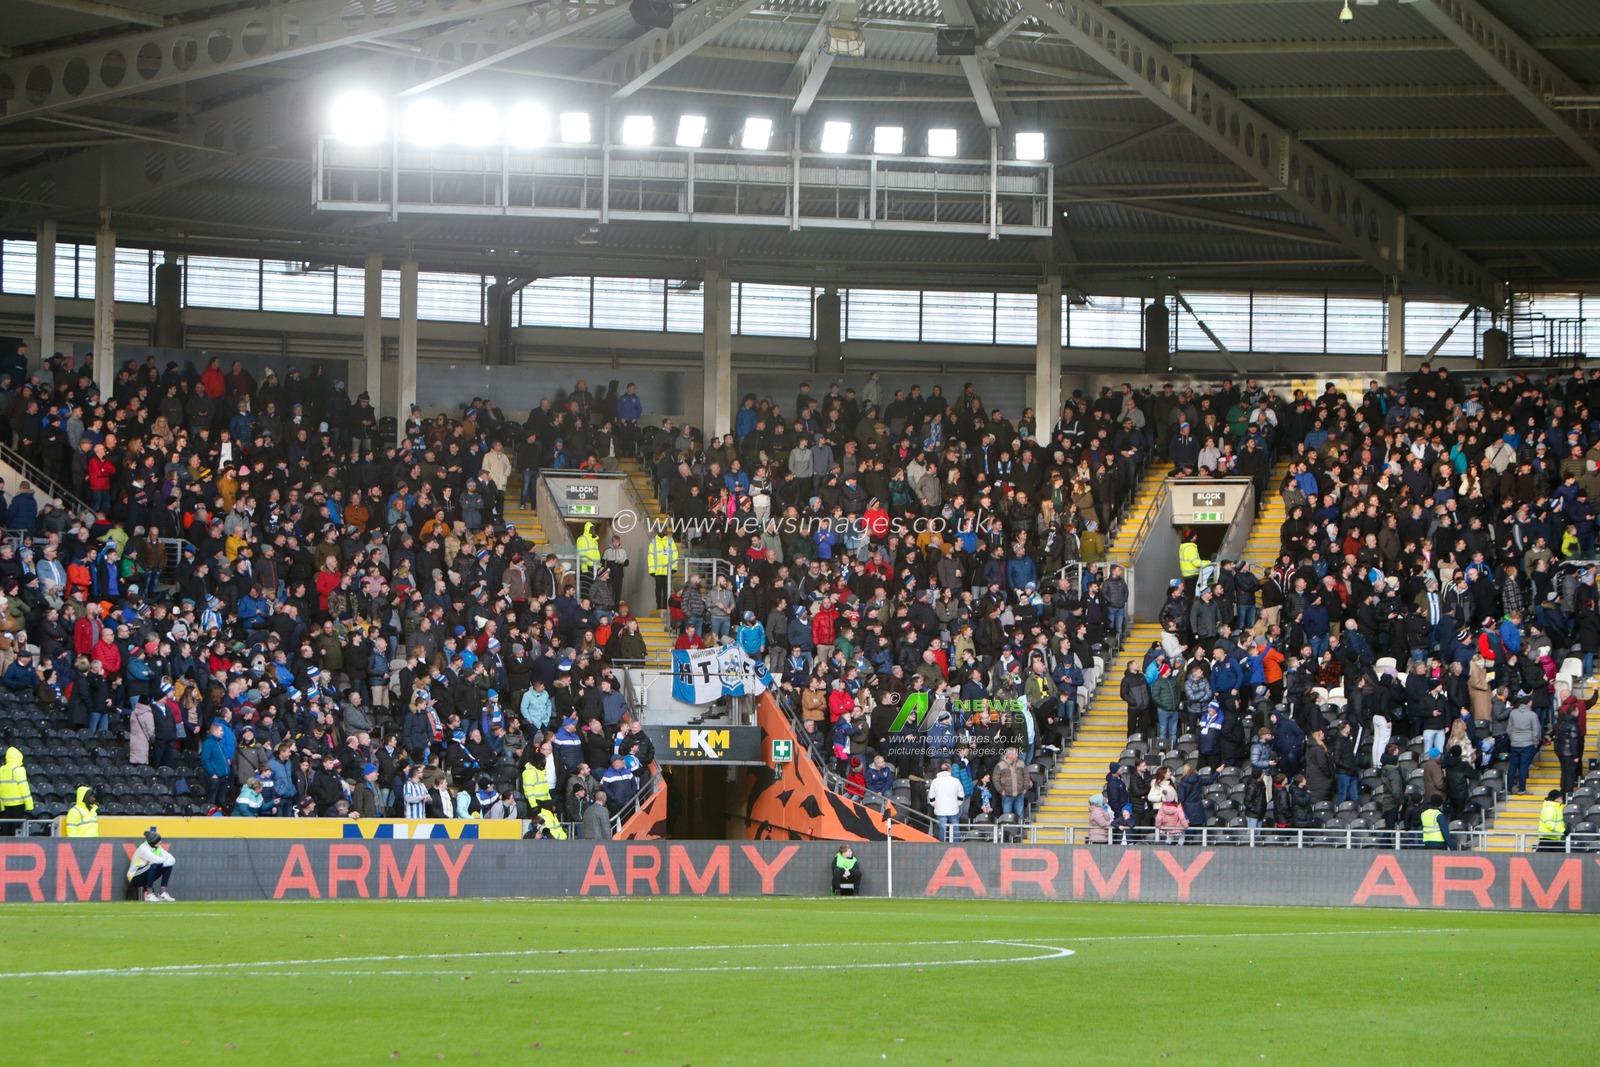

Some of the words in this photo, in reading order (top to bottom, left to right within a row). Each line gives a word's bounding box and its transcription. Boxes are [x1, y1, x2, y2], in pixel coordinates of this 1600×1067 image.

[669, 729, 730, 758] MKM
[273, 844, 474, 898] ARMY
[579, 845, 800, 895] ARMY
[924, 847, 1216, 900] ARMY
[1352, 854, 1600, 910] ARM
